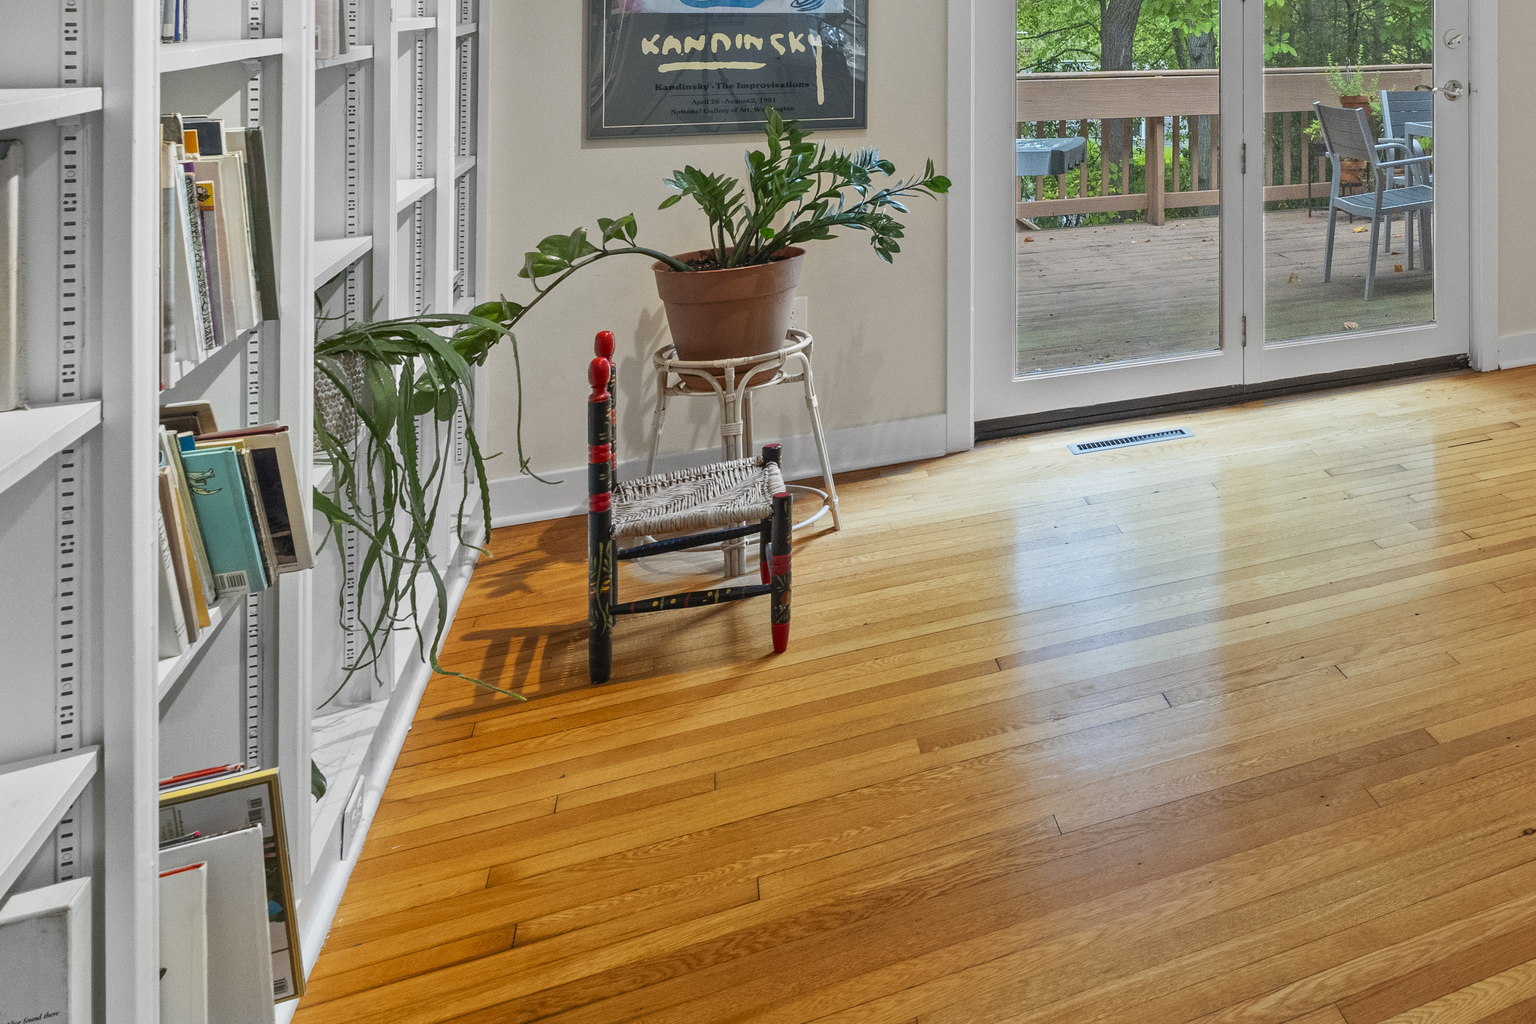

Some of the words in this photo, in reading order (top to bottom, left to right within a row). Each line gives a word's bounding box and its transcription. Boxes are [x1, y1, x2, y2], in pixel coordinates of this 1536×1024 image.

[641, 31, 824, 105] KANDINSKY
[655, 84, 709, 92] Kandinsky
[737, 82, 809, 90] Improvisations
[23, 1014, 42, 1024] found
[44, 1011, 59, 1019] there
